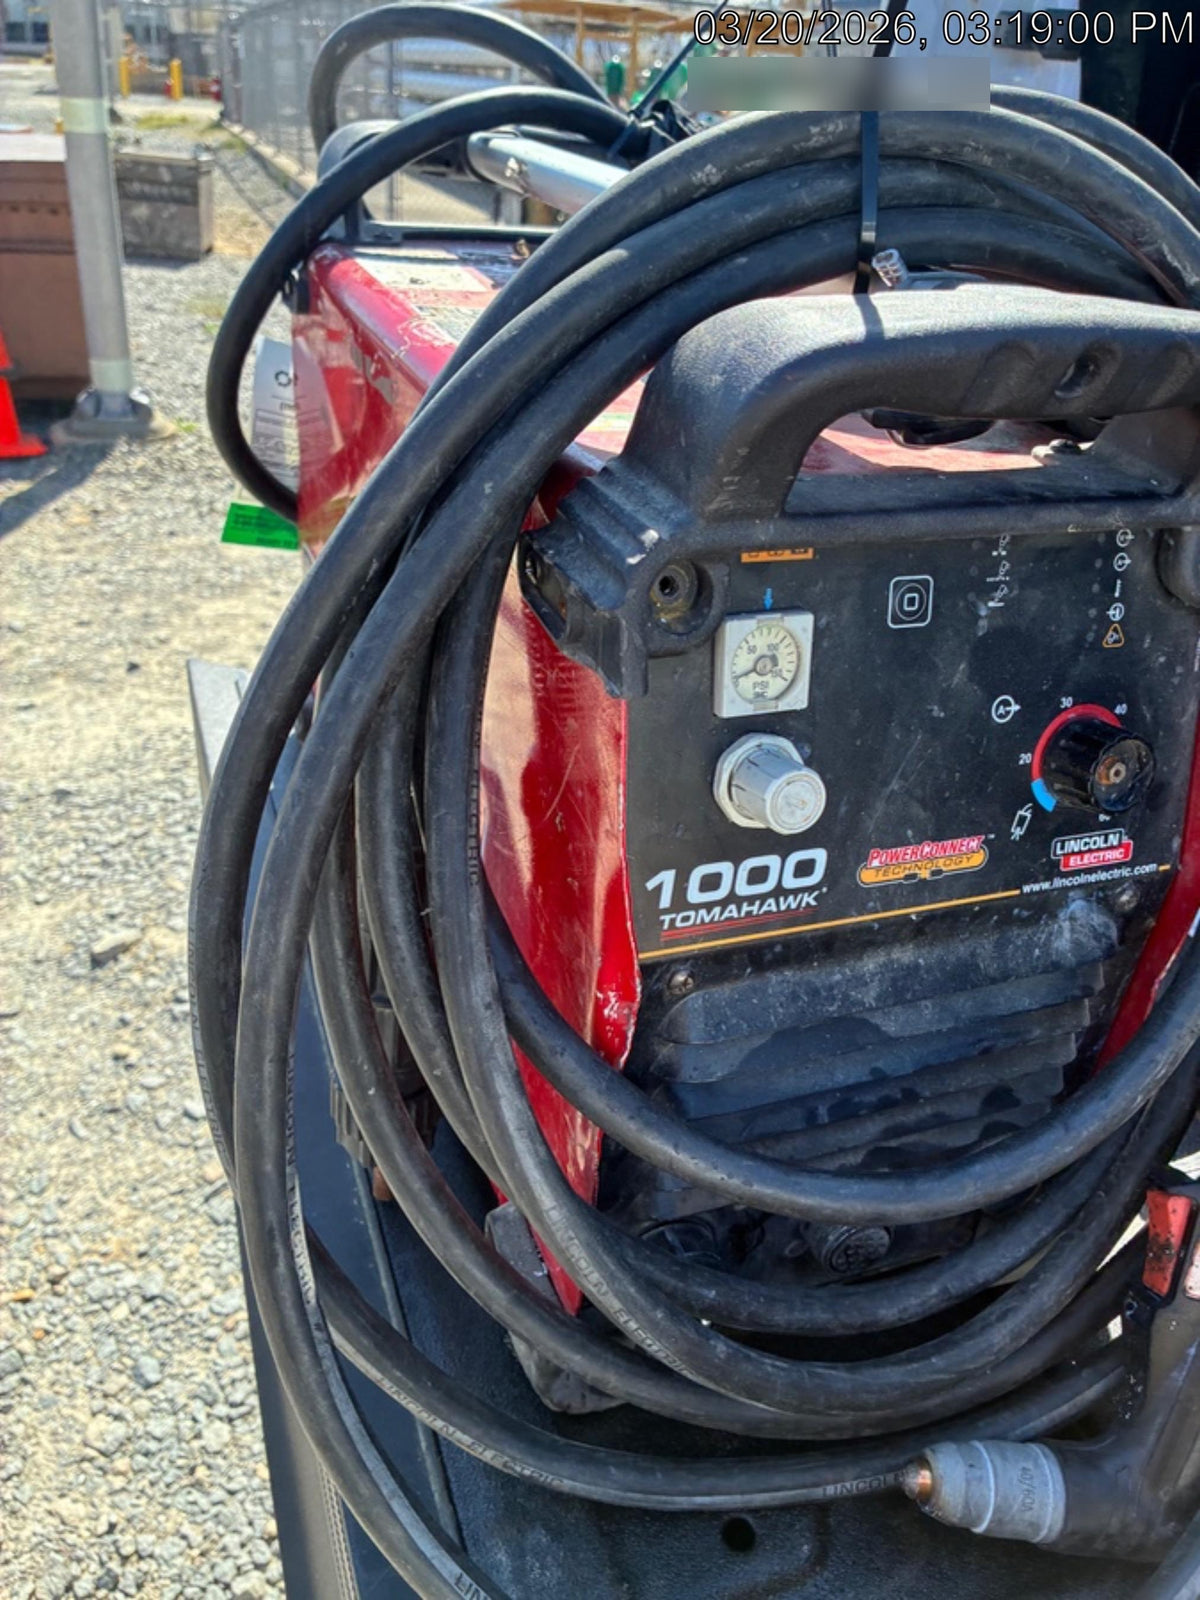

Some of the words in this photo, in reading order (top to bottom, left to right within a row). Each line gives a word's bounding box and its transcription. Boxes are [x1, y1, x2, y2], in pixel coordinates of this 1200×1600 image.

[1060, 697, 1074, 708] 30
[1114, 703, 1128, 715] 40
[1018, 753, 1032, 765] 20
[1055, 832, 1121, 856] LINCOLN
[873, 854, 974, 878] TECHNOLOGY
[1068, 848, 1126, 867] ELECTRIC
[645, 847, 828, 910] 1000
[1022, 862, 1158, 894] www.lincolnelectric.com
[659, 889, 820, 931] TOMAHAWK
